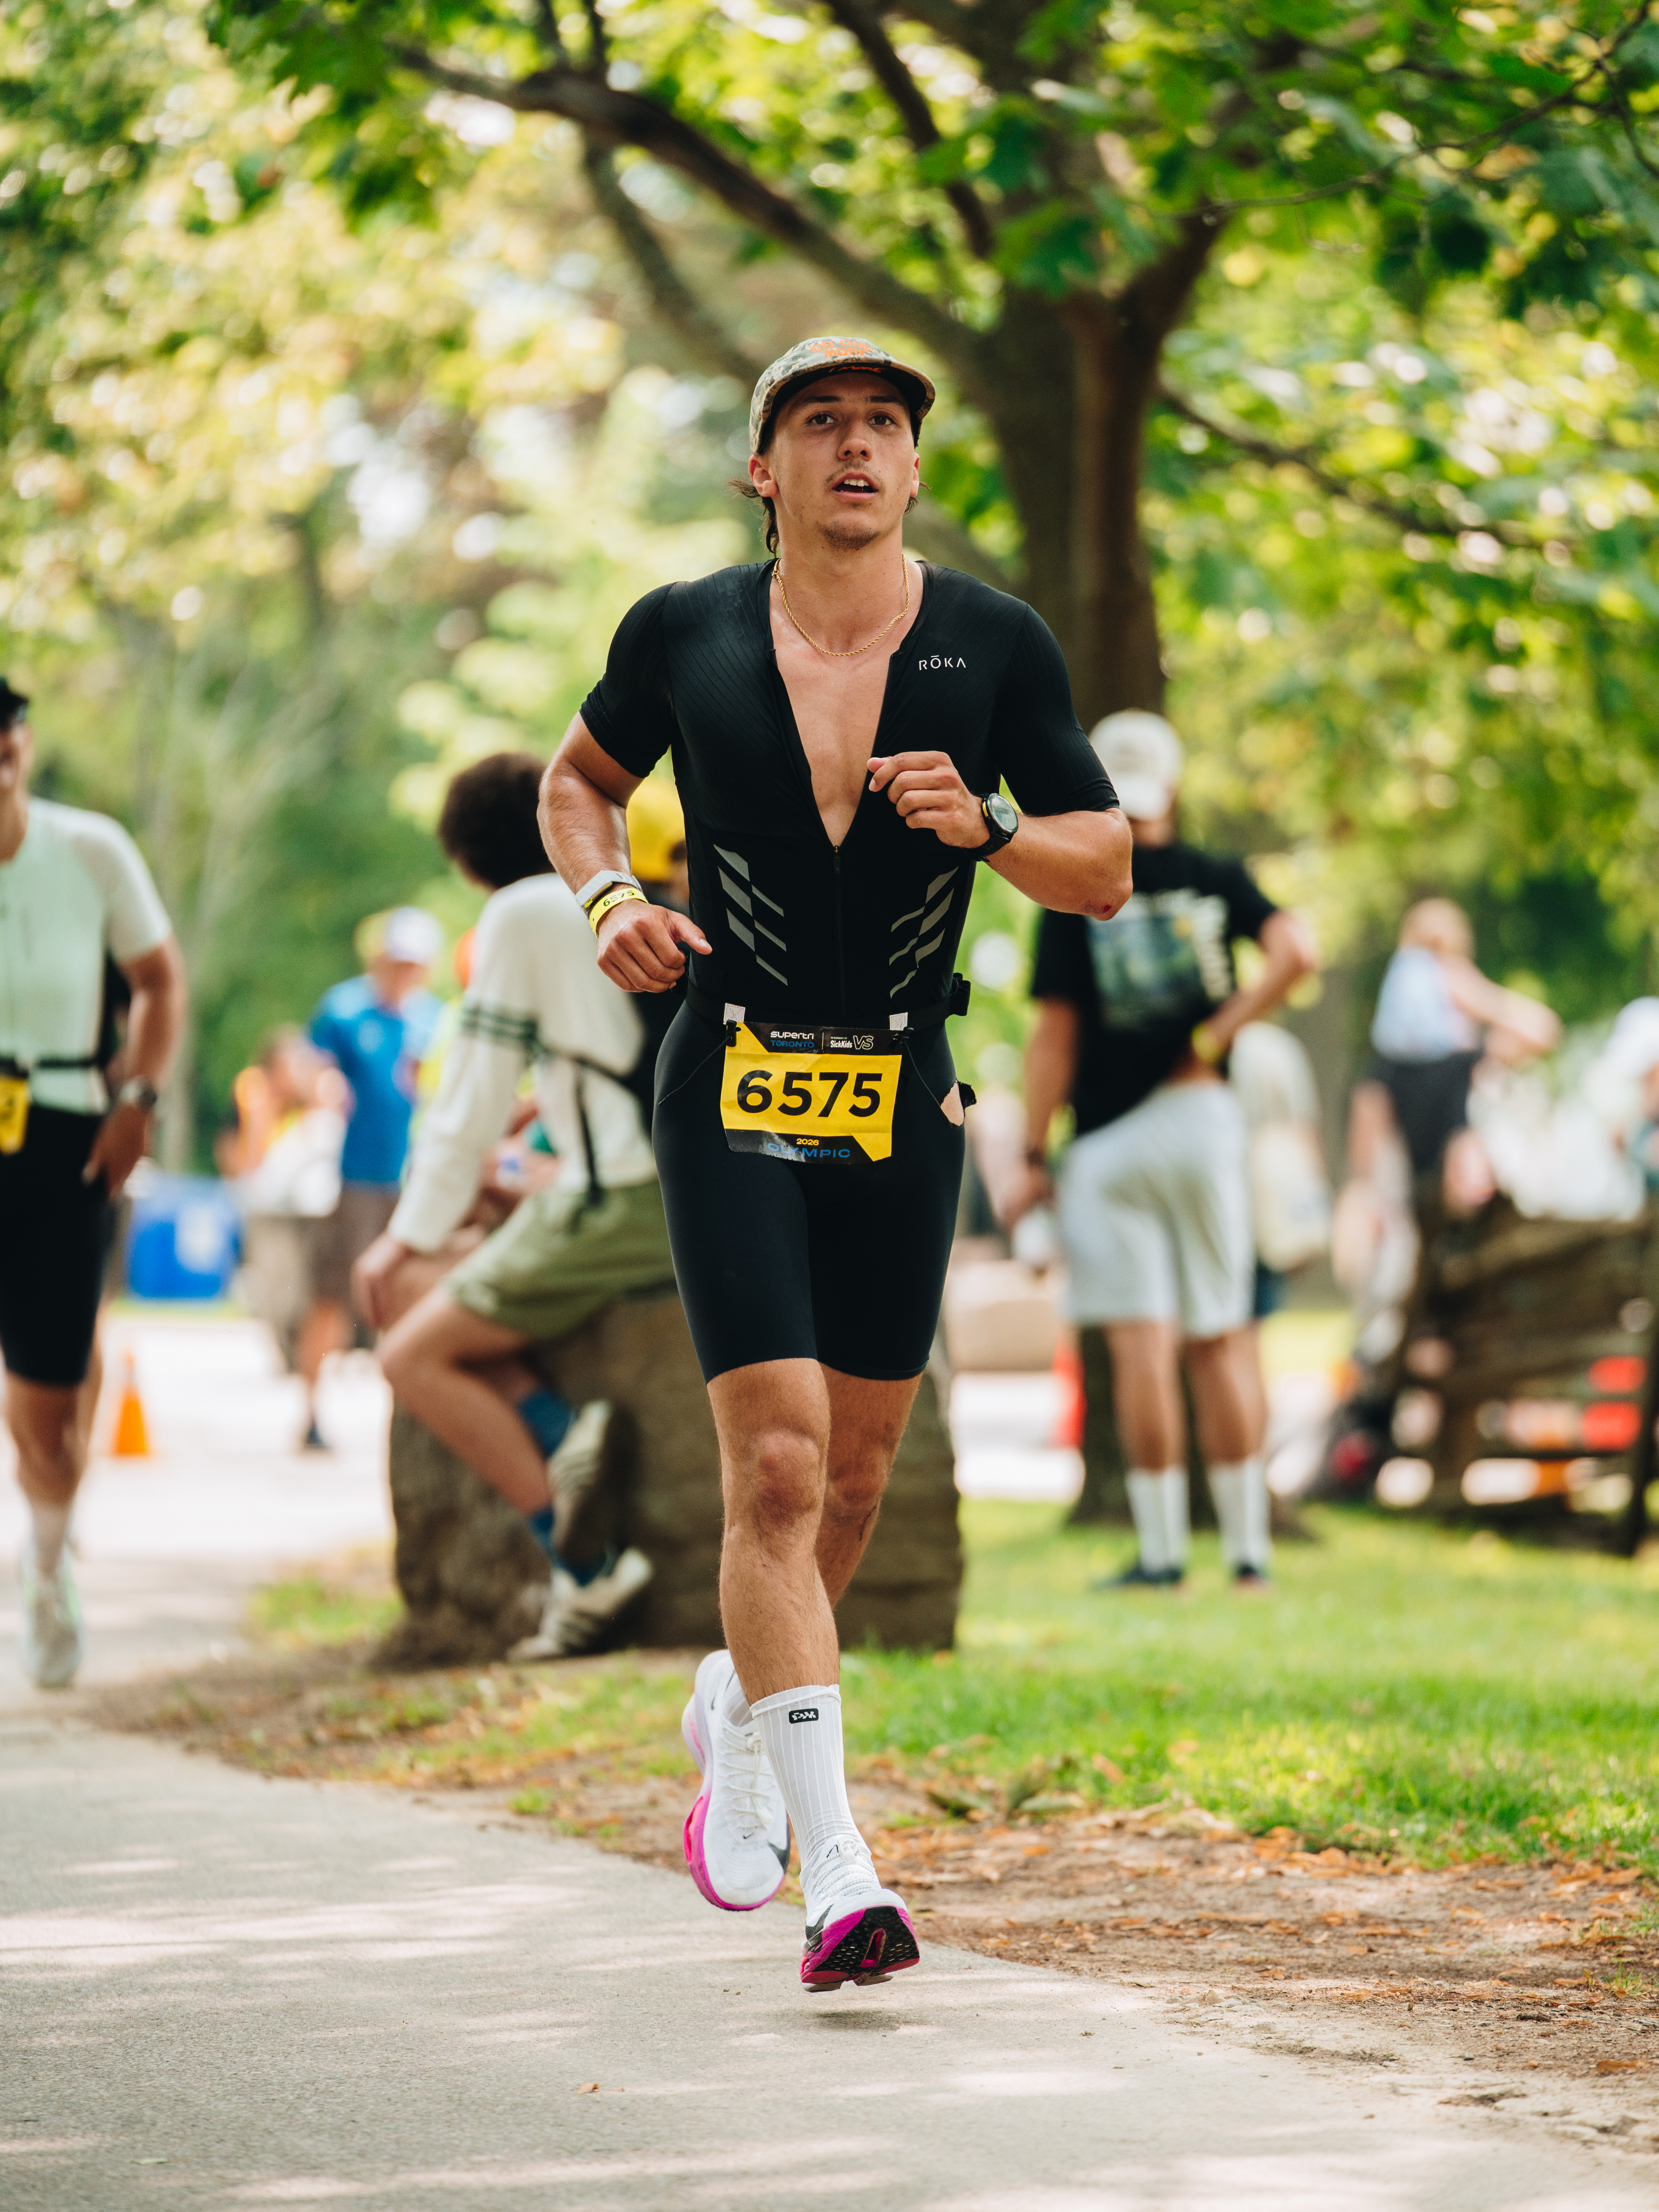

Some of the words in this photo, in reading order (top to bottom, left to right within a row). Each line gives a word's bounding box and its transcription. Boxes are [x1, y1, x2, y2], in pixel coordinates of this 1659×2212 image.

[810, 341, 835, 353] GO
[840, 340, 874, 354] ONE
[824, 348, 867, 358] MORE
[603, 890, 635, 906] 6575
[770, 1040, 814, 1048] TORONTO
[830, 1040, 852, 1048] SickKids
[853, 1035, 874, 1050] VS
[737, 1070, 883, 1117] 6575
[767, 1143, 851, 1158] OLYMPIC
